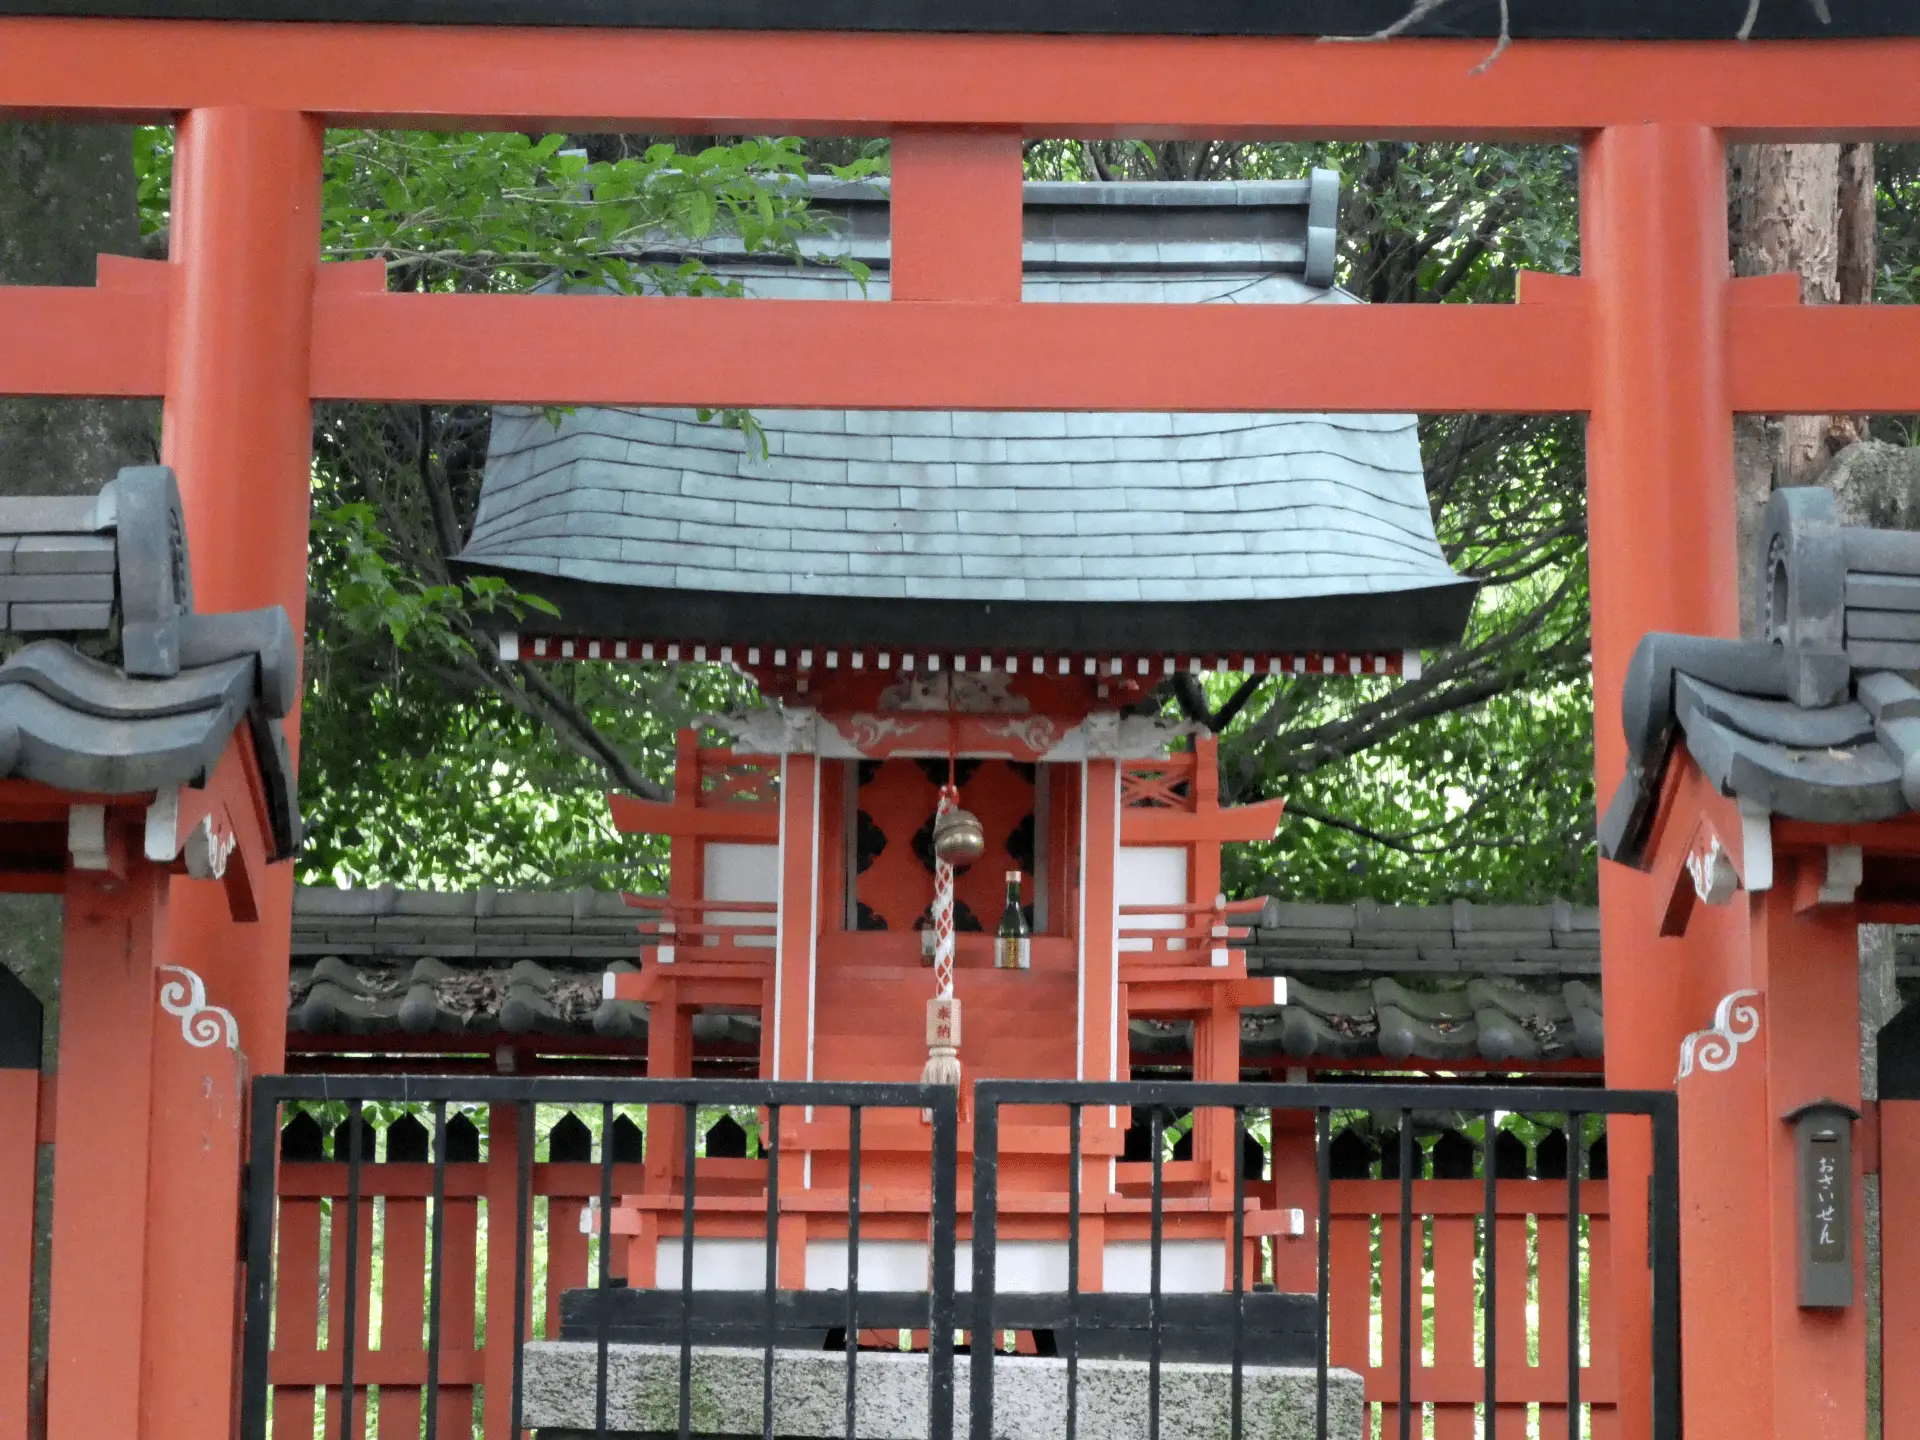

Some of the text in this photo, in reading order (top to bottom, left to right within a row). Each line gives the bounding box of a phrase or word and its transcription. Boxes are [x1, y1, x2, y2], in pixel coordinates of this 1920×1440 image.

[1816, 1156, 1835, 1245] おさいせん
